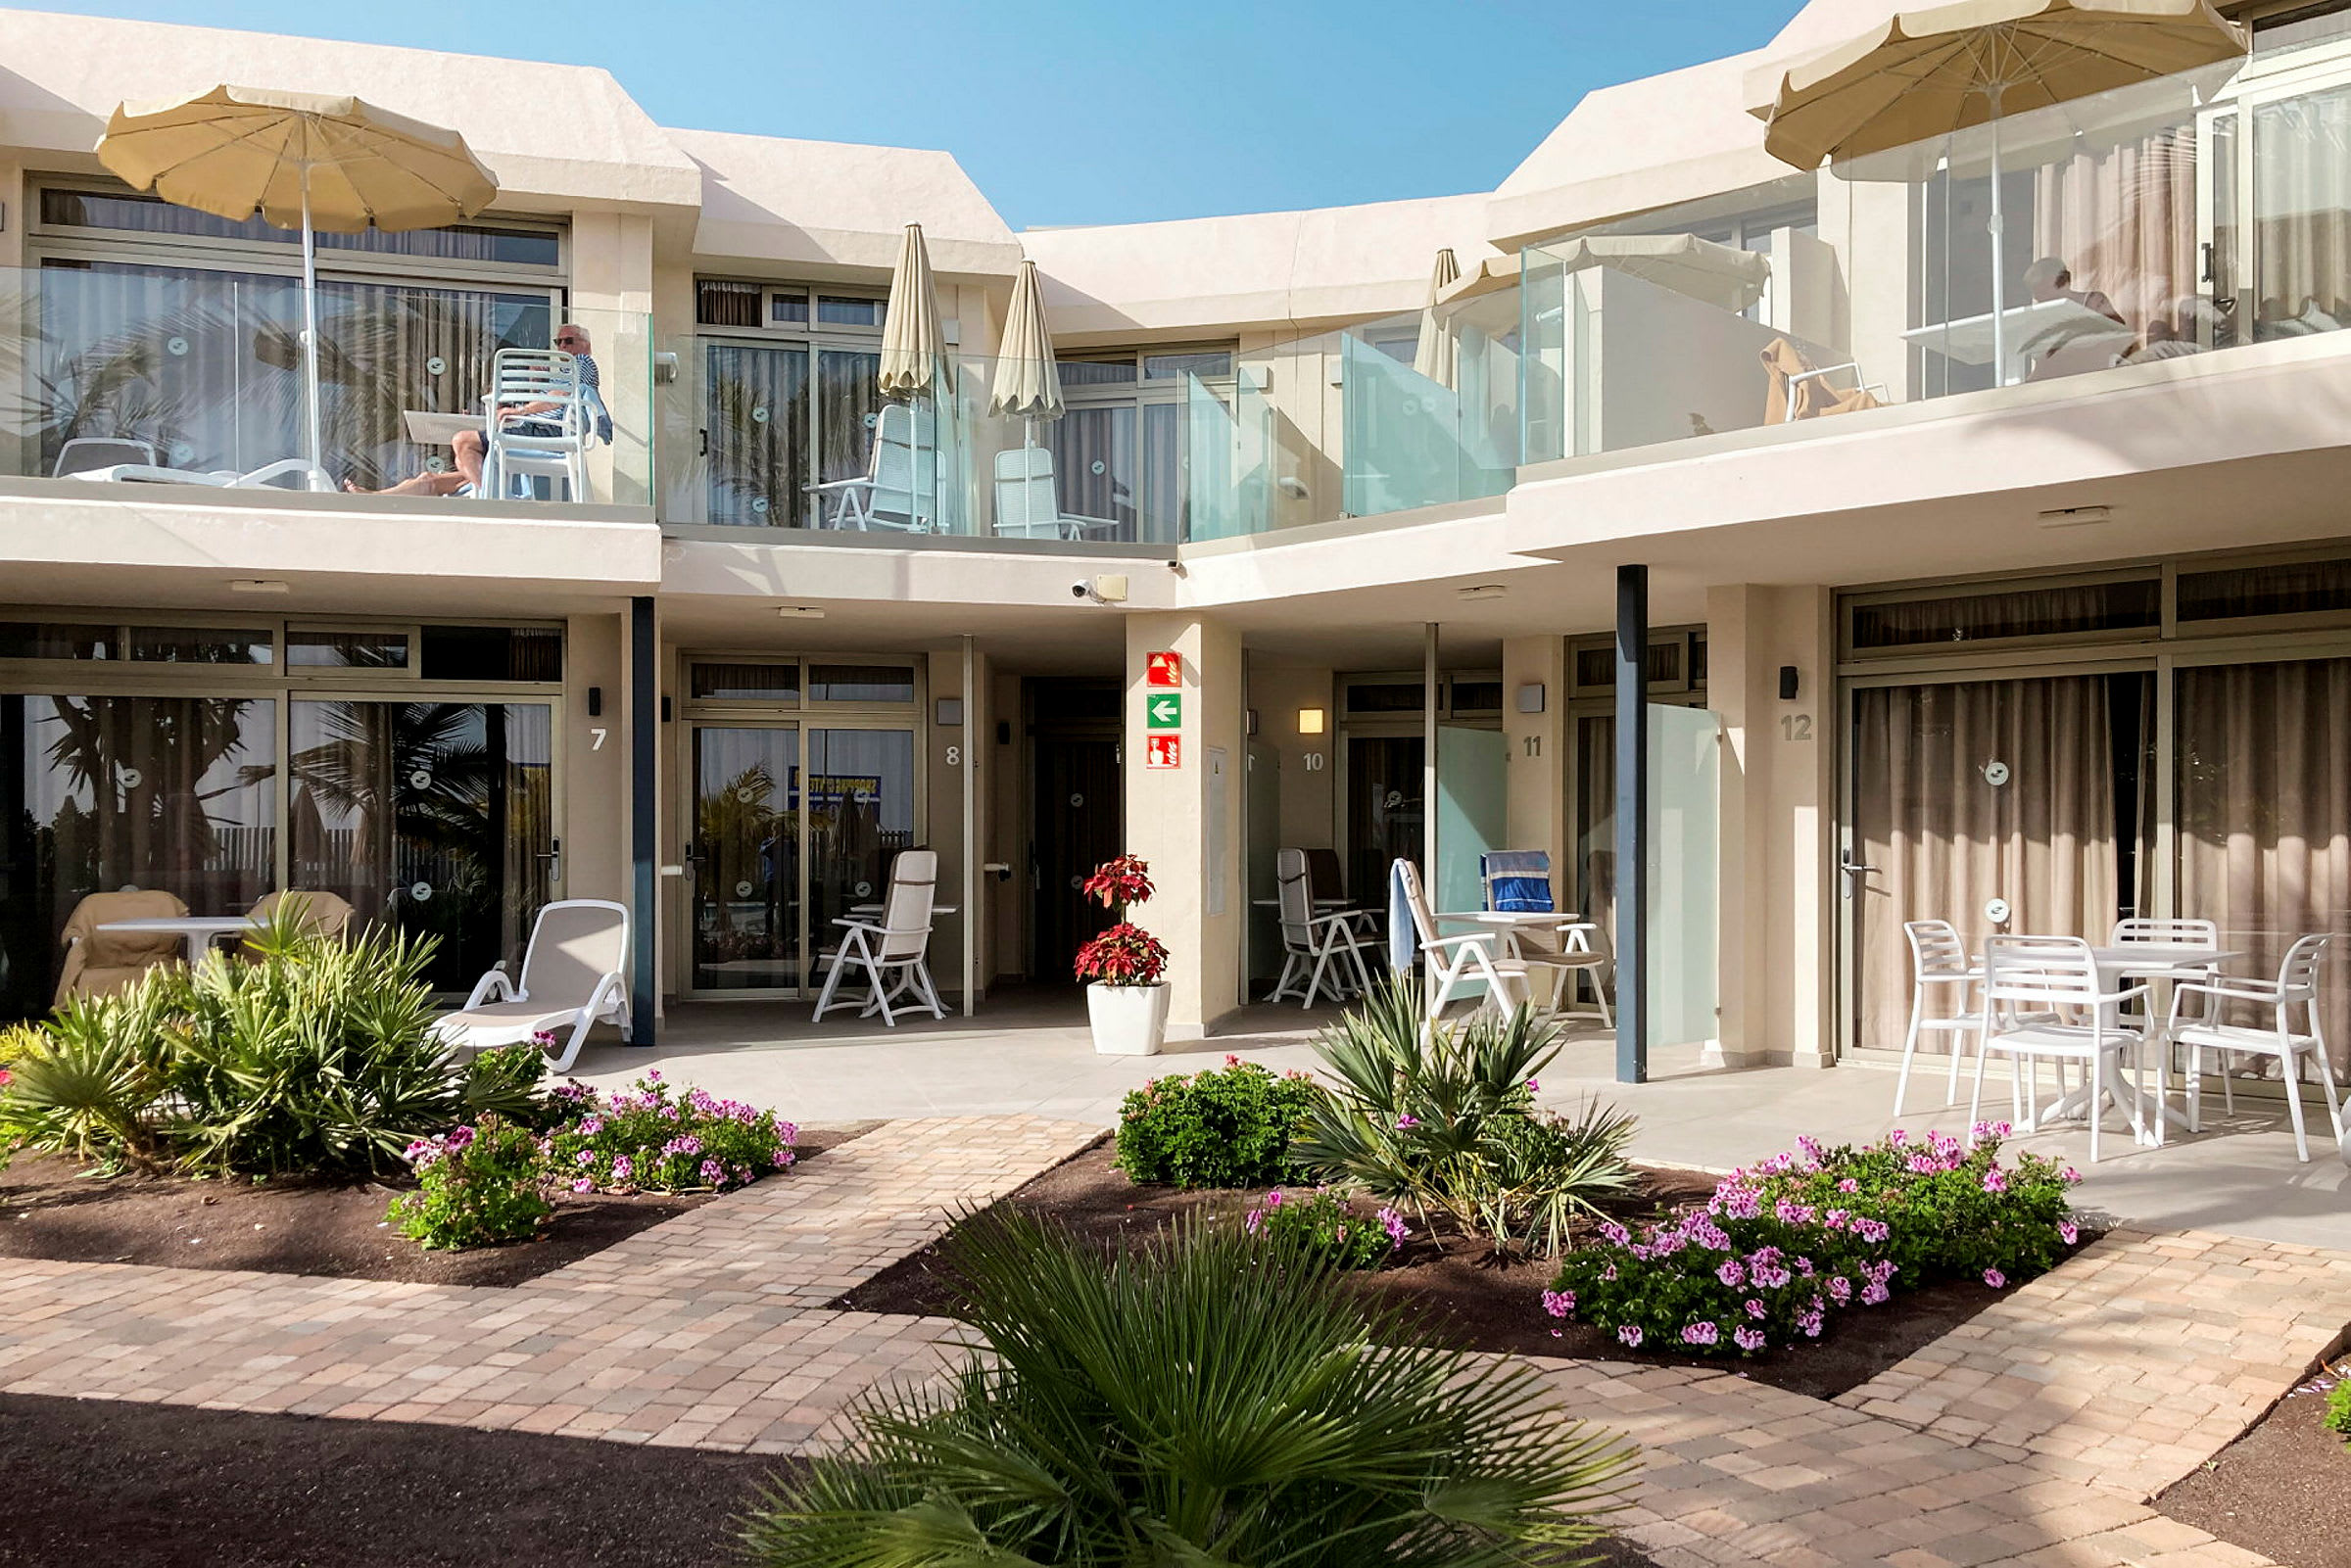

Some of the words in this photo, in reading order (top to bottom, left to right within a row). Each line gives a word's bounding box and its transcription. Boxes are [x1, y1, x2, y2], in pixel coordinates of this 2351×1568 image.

[1780, 714, 1811, 741] 12
[591, 728, 606, 751] 7
[1523, 736, 1541, 757] 11
[946, 746, 960, 766] 8
[1303, 753, 1323, 771] 10
